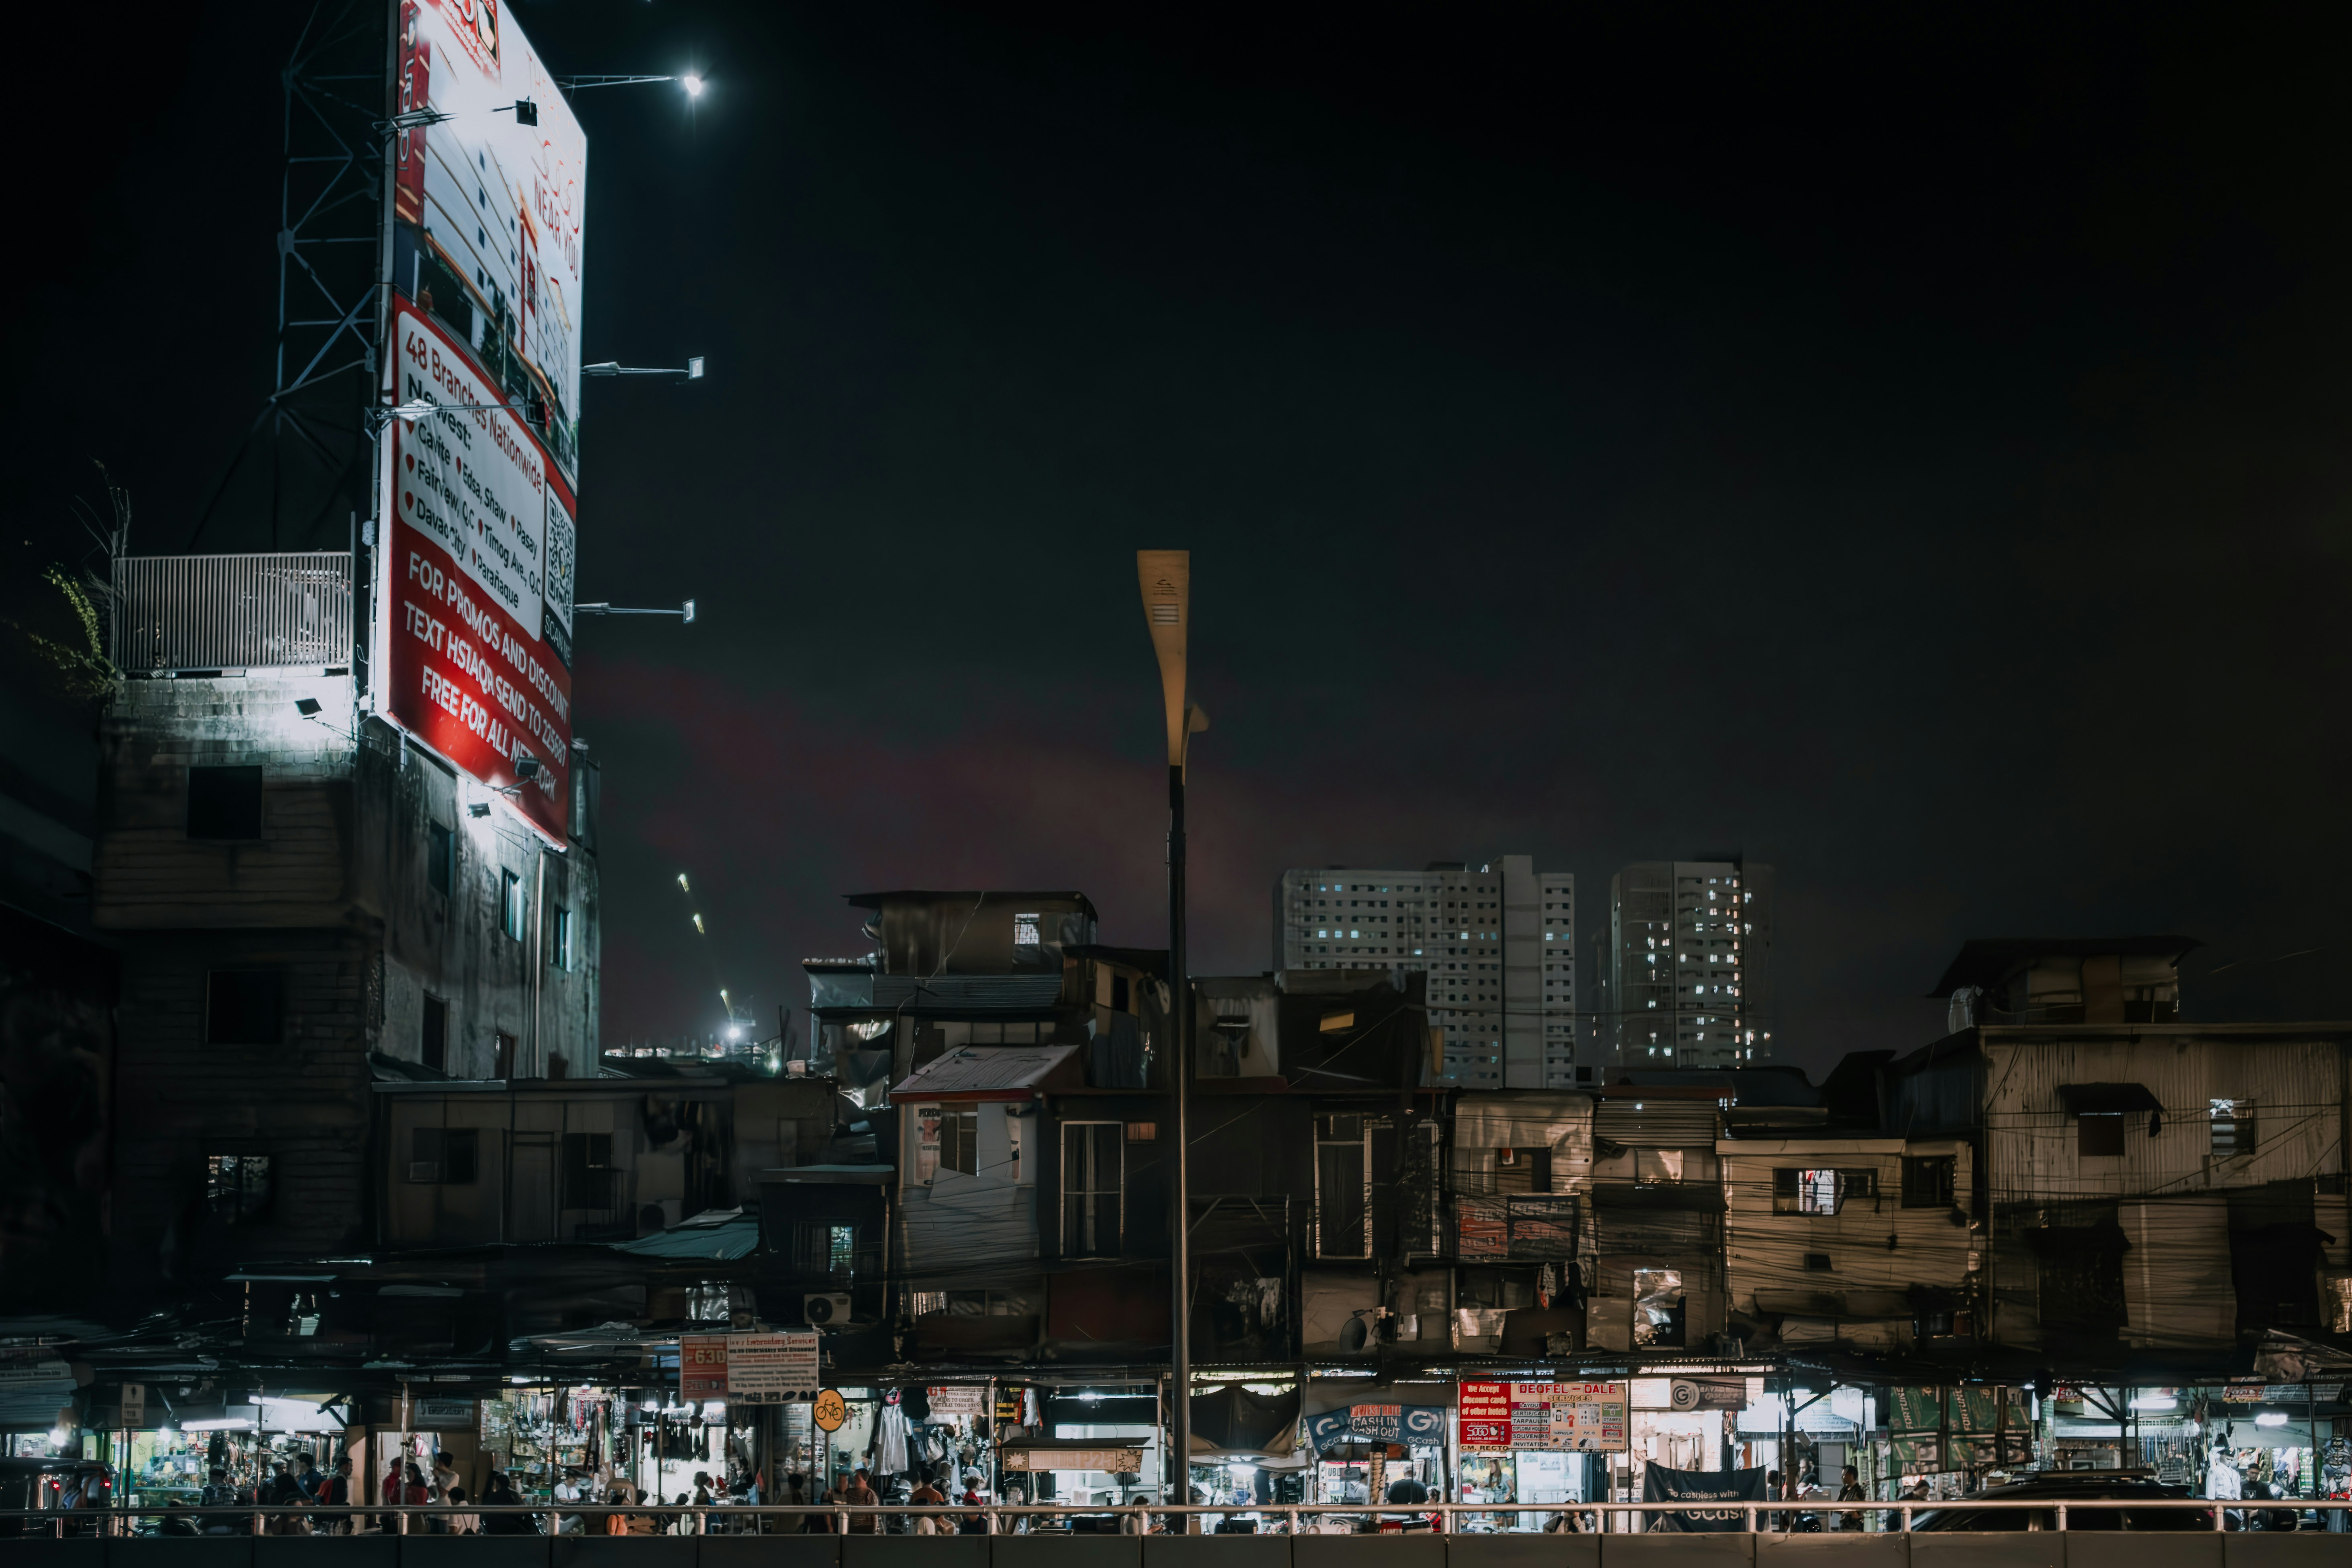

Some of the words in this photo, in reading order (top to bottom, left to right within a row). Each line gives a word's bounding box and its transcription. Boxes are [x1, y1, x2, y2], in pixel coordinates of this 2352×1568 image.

[400, 58, 414, 162] SOO
[534, 173, 561, 250] NEAR
[563, 222, 578, 282] YOU
[406, 330, 427, 370] 48
[432, 348, 486, 430] Branches
[490, 408, 542, 495] Nationwide
[408, 373, 471, 451] Newest:
[418, 422, 451, 465] Cavite
[463, 463, 483, 505] Edsa,
[484, 490, 506, 524] Shaw
[462, 501, 475, 530] QC
[517, 520, 537, 561] Pasay
[484, 524, 508, 569] Timog
[529, 571, 541, 597] QC
[477, 554, 519, 609] Parañaque
[409, 551, 444, 600] FOR
[447, 578, 500, 651] PROMOS
[502, 632, 526, 674] AND
[528, 655, 569, 724] DISCOUNT
[545, 615, 563, 653] SCAN
[404, 600, 445, 651] TEXT
[496, 675, 526, 722] SEND
[529, 703, 541, 736] TO
[422, 665, 460, 717] FREE
[460, 693, 488, 739] FOR
[486, 718, 508, 758] ALL
[510, 736, 556, 802] NEORK
[695, 1350, 726, 1364] 630
[1463, 1396, 1489, 1404] discount
[1490, 1396, 1507, 1404] cards
[1479, 1385, 1499, 1394] Accept
[1519, 1384, 1569, 1394] DEOFEL
[1584, 1384, 1616, 1394] DALE
[1896, 1387, 1914, 1429] FORTUNE
[1352, 1417, 1383, 1428] CASH
[1387, 1416, 1397, 1427] IN
[1462, 1407, 1469, 1415] of
[1470, 1407, 1487, 1415] other
[1488, 1407, 1507, 1415] hotels
[1320, 1435, 1343, 1450] GCa
[1352, 1425, 1379, 1437] CASH
[1380, 1427, 1401, 1438] OUT
[1407, 1436, 1439, 1445] GCash
[1079, 1452, 1115, 1468] P25
[1680, 1490, 1718, 1500] cashless
[1720, 1489, 1739, 1498] with
